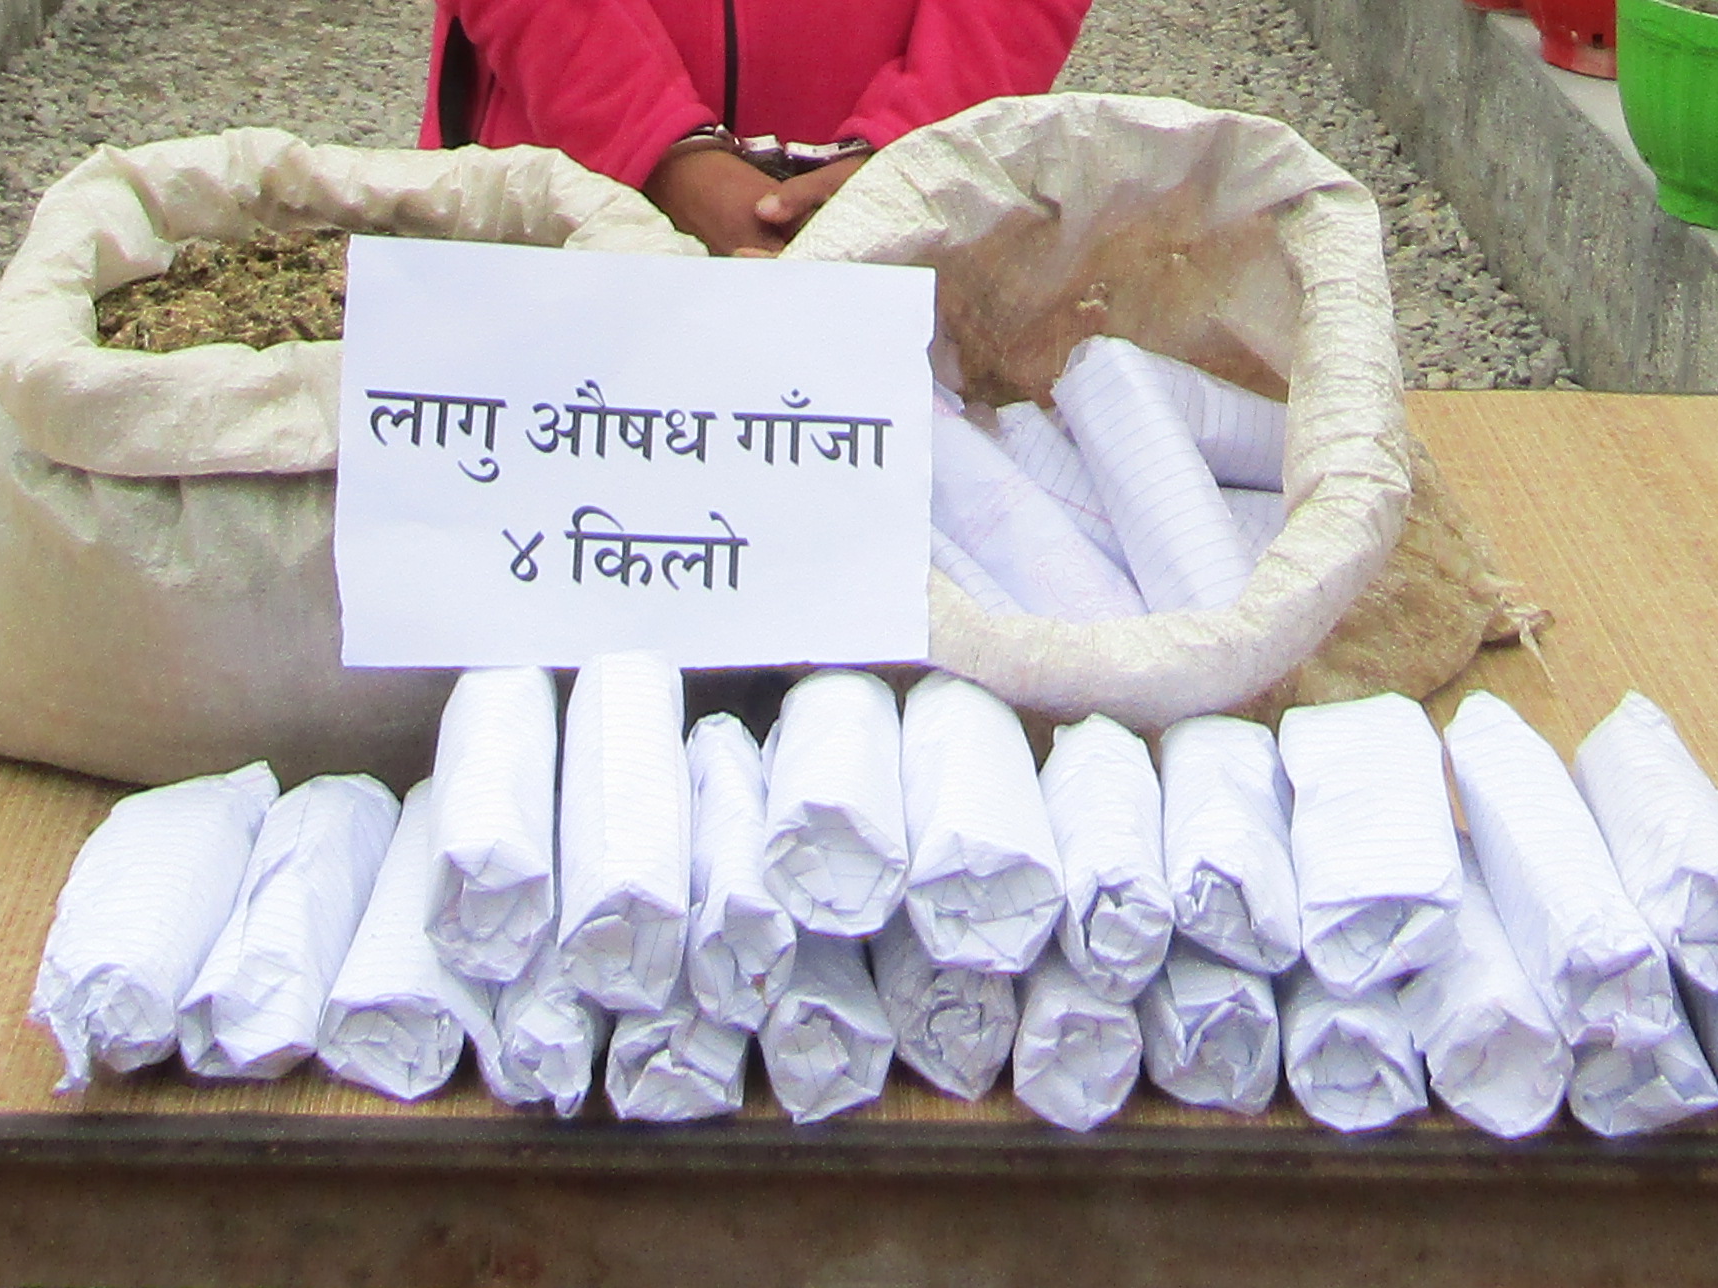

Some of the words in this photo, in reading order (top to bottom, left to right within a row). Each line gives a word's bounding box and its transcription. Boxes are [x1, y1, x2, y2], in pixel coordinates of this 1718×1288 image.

[365, 389, 507, 482] लागु
[526, 379, 716, 462] औषध
[733, 389, 893, 469] गाँजा
[502, 529, 545, 582] ४
[565, 506, 749, 591] किलो
